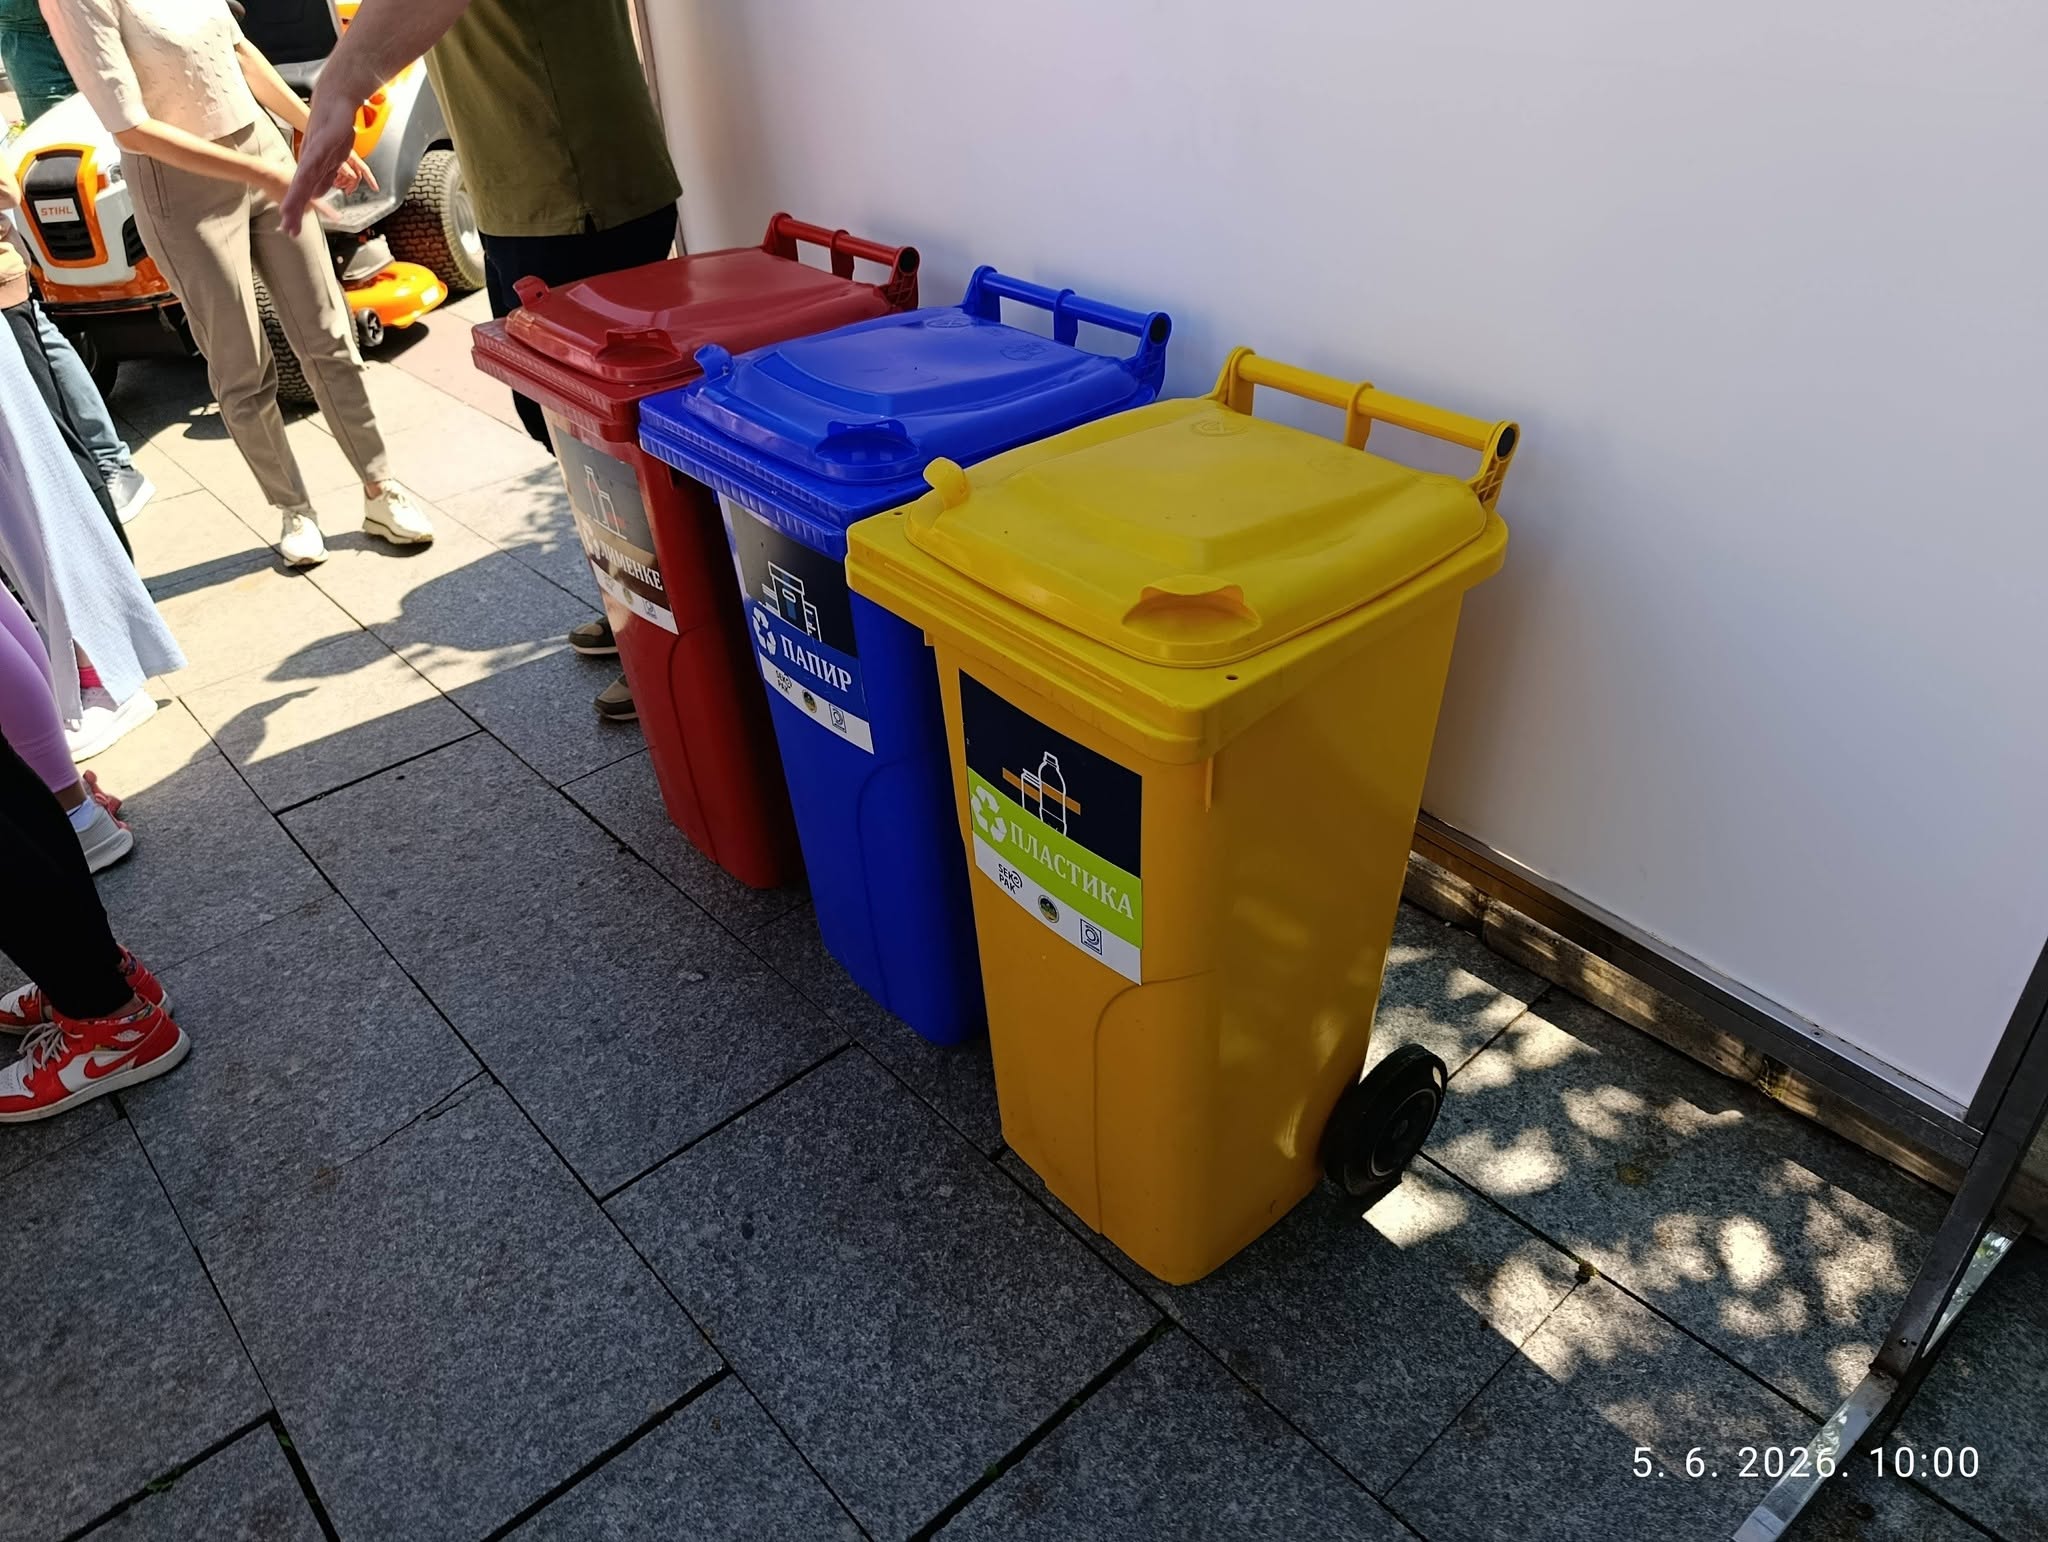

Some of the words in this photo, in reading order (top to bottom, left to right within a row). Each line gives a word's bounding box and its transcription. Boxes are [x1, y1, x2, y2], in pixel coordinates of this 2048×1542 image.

[41, 205, 73, 217] STIHL
[780, 633, 852, 692] ПАПИР
[999, 873, 1016, 894] PAK
[1010, 820, 1134, 920] ПЛАСТИКА
